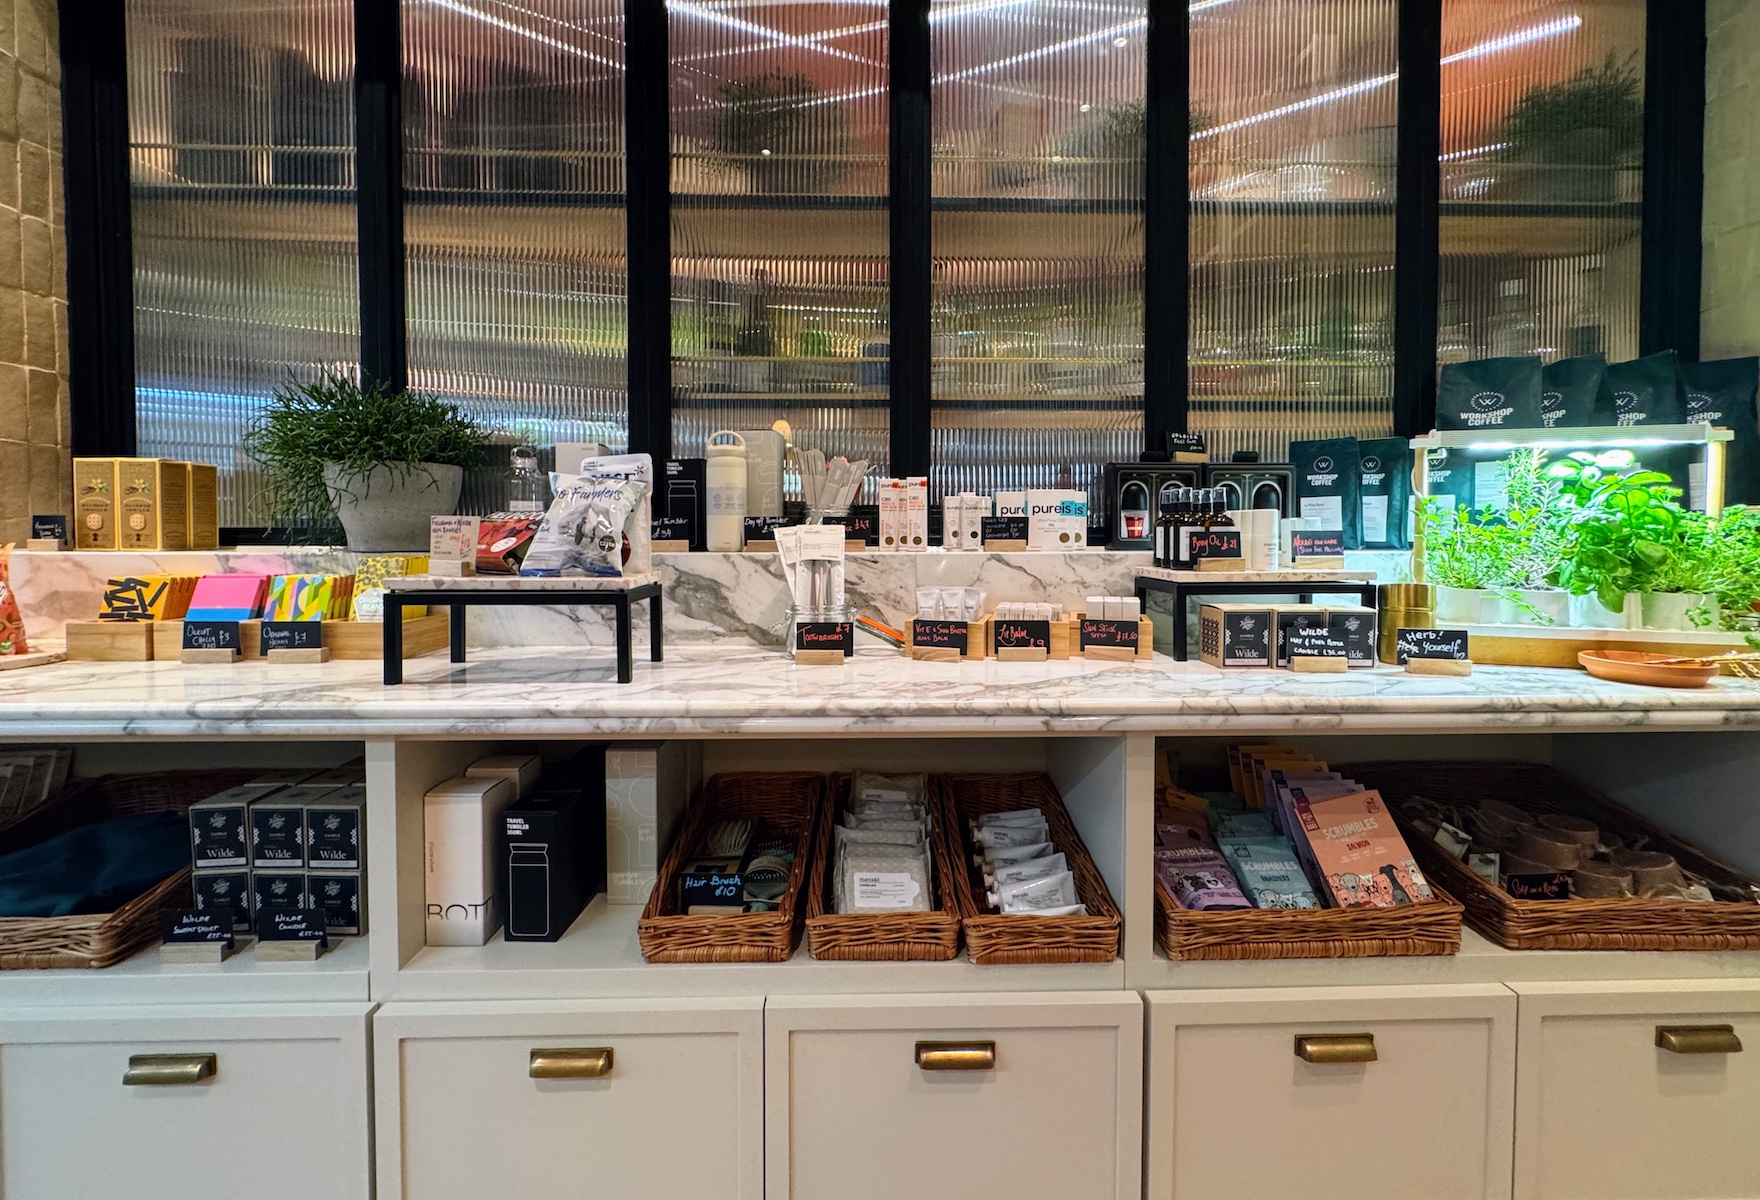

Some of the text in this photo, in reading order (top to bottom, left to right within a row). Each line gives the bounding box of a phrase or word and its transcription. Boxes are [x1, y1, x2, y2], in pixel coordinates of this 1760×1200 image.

[1460, 407, 1514, 420] WORKSHOP
[1541, 409, 1567, 421] SHOP
[1618, 411, 1647, 421] SHOP
[1468, 416, 1504, 427] COFFEE
[1307, 473, 1339, 481] WORKSHOP
[1032, 502, 1072, 516] pureis
[1299, 628, 1330, 636] WILDE
[1406, 631, 1444, 642] Herb!
[1234, 649, 1260, 658] Wilde
[1293, 648, 1320, 656] CANDLE
[1349, 650, 1364, 659] ilde
[1322, 818, 1379, 840] SCRUMBLES
[1346, 840, 1371, 851] SALMON
[207, 848, 235, 858] Wilde
[265, 849, 292, 859] Wilde
[319, 850, 348, 860] Wilde
[1241, 861, 1298, 871] SCRUMBLES
[710, 875, 742, 886] Brush
[715, 886, 736, 897] £10
[182, 914, 211, 924] WILDE
[275, 914, 304, 924] WILDE
